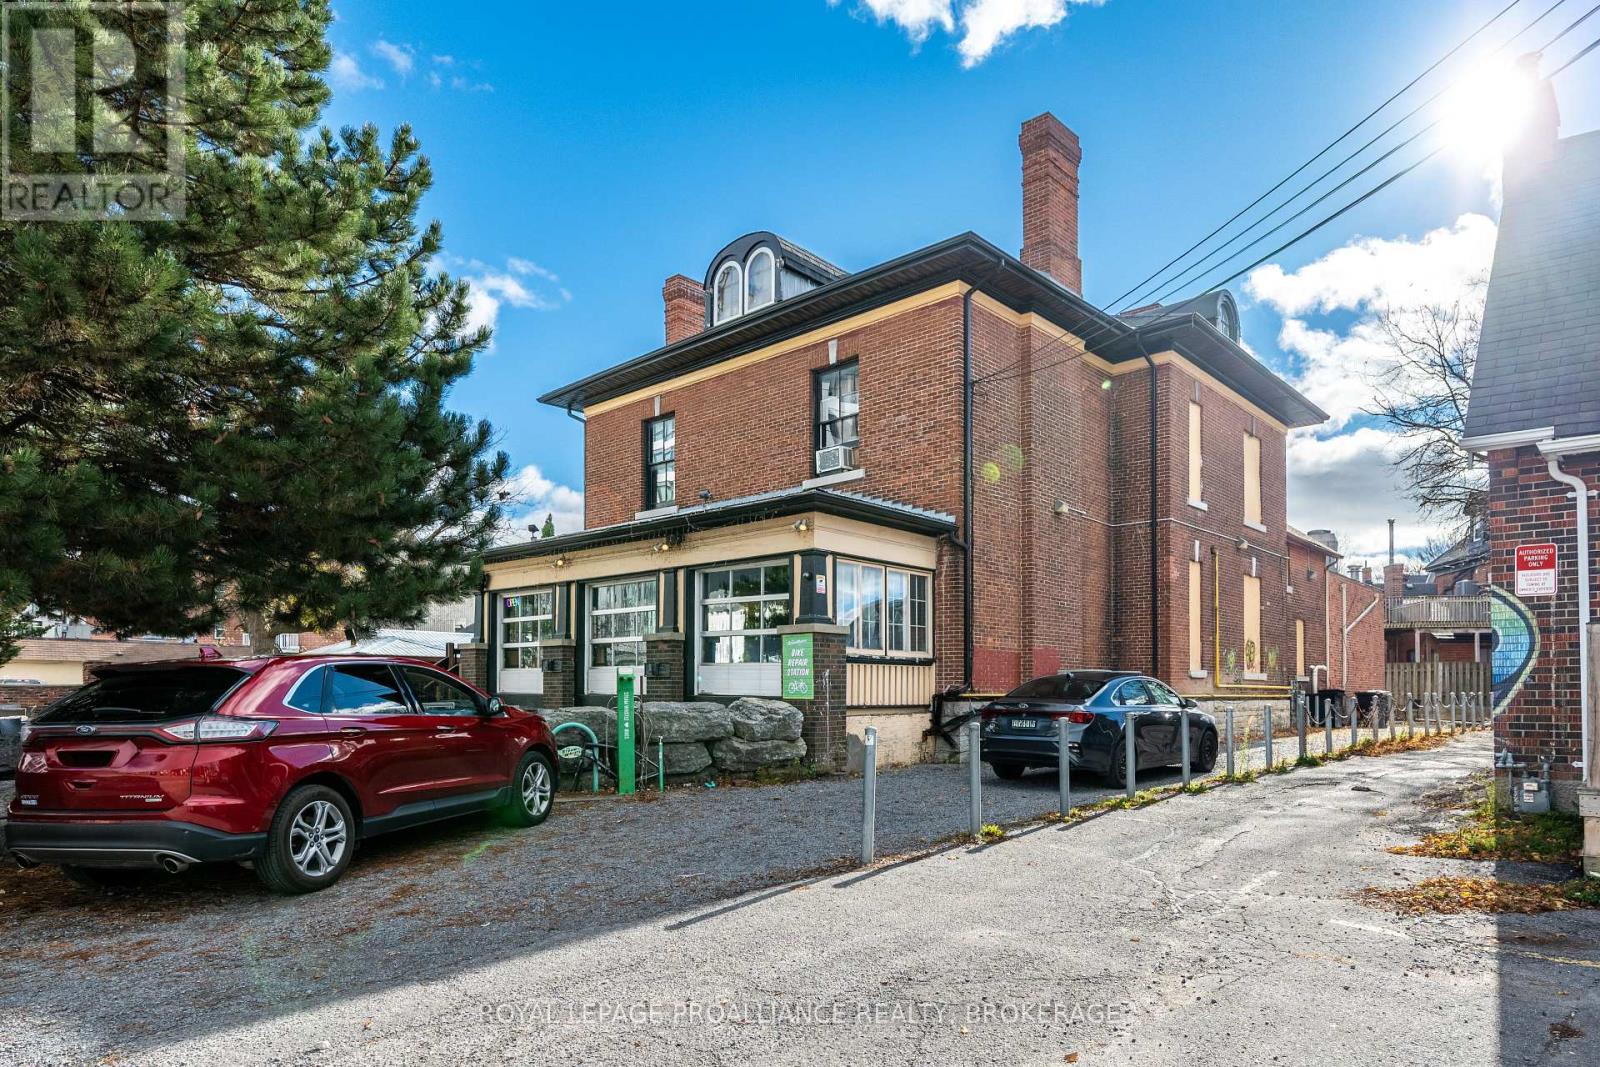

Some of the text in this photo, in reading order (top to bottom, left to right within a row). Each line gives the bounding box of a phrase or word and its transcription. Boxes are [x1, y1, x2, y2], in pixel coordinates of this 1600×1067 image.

[791, 648, 805, 657] BIKE
[788, 658, 808, 667] REPAIR
[787, 668, 809, 676] STATION
